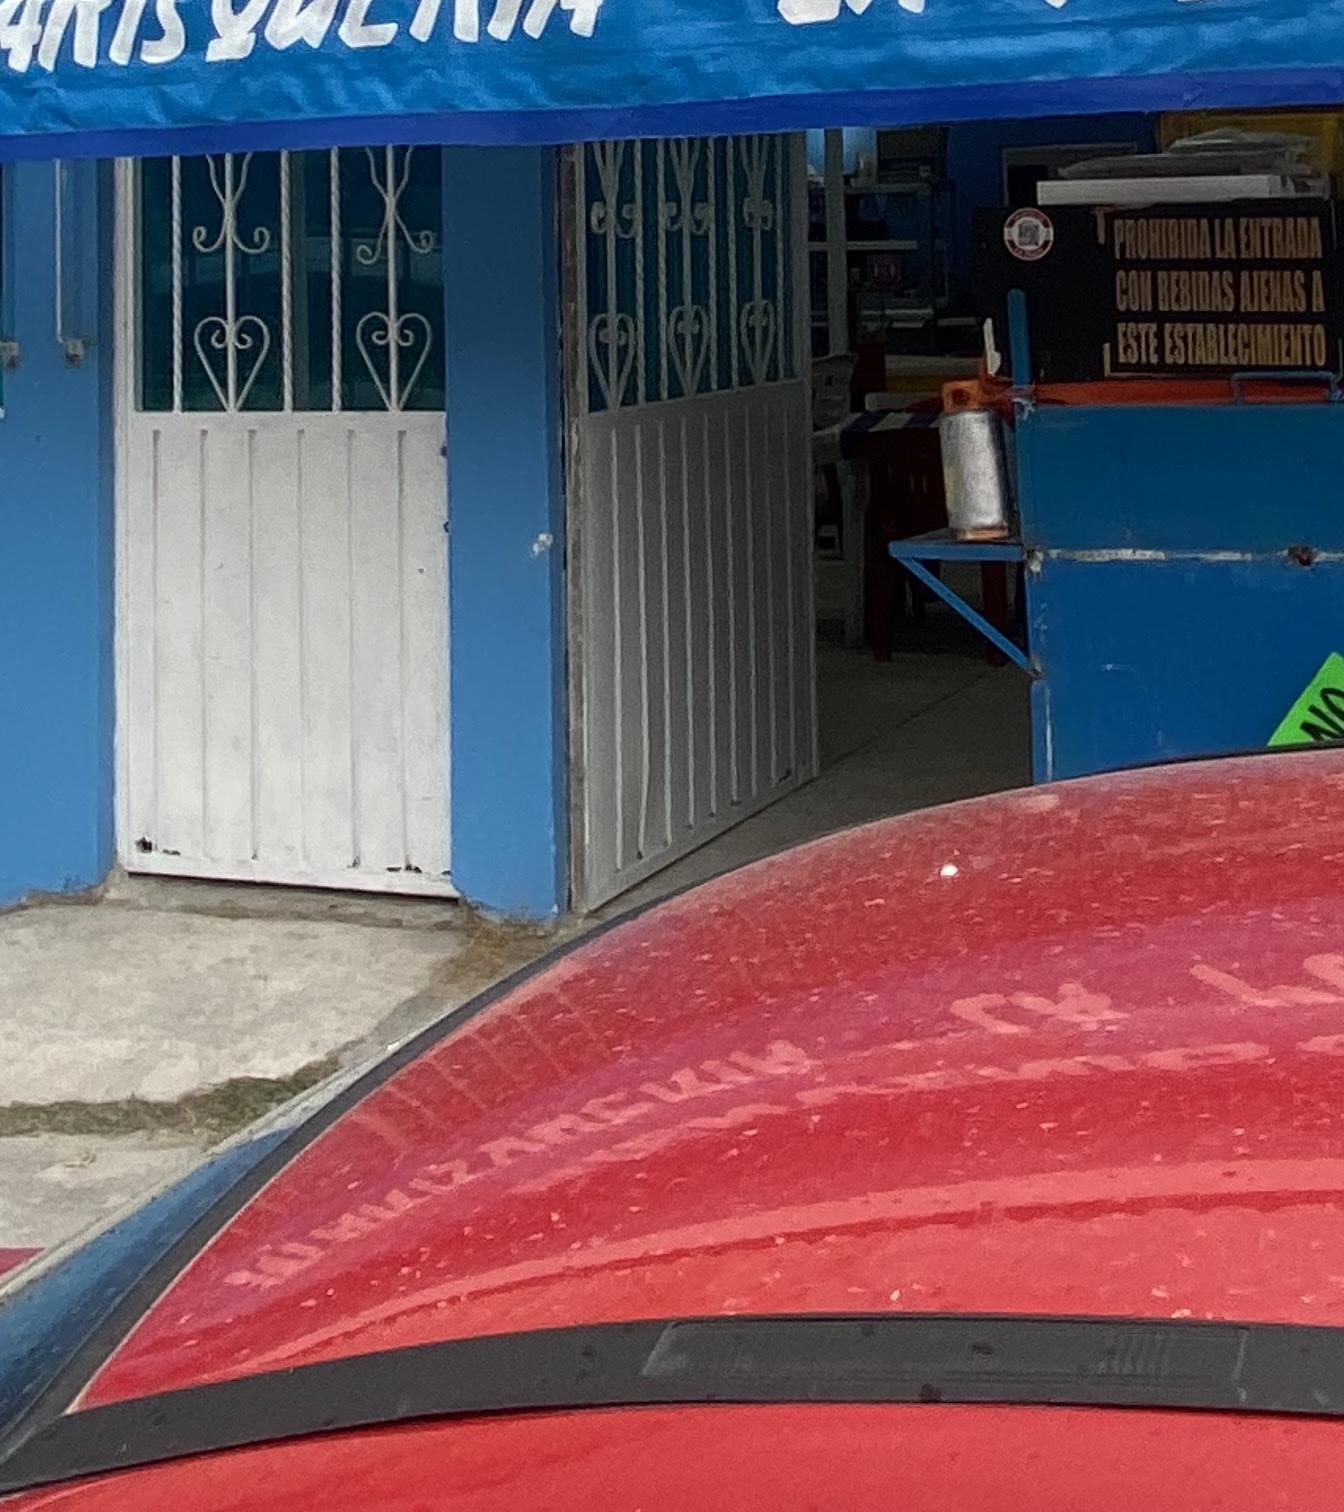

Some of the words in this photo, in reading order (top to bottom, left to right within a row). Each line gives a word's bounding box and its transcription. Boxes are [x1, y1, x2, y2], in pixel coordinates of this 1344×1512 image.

[1113, 217, 1211, 260] PROHIBIDA
[1214, 218, 1237, 260] LA
[1239, 216, 1324, 260] ENTRADA
[1115, 269, 1153, 312] CON
[1157, 270, 1235, 312] BEBIDAS
[1240, 270, 1307, 312] AJENAS
[1312, 270, 1325, 312] A
[1117, 322, 1158, 364] ESTE
[1164, 323, 1327, 366] ESTABLECIMIENTO
